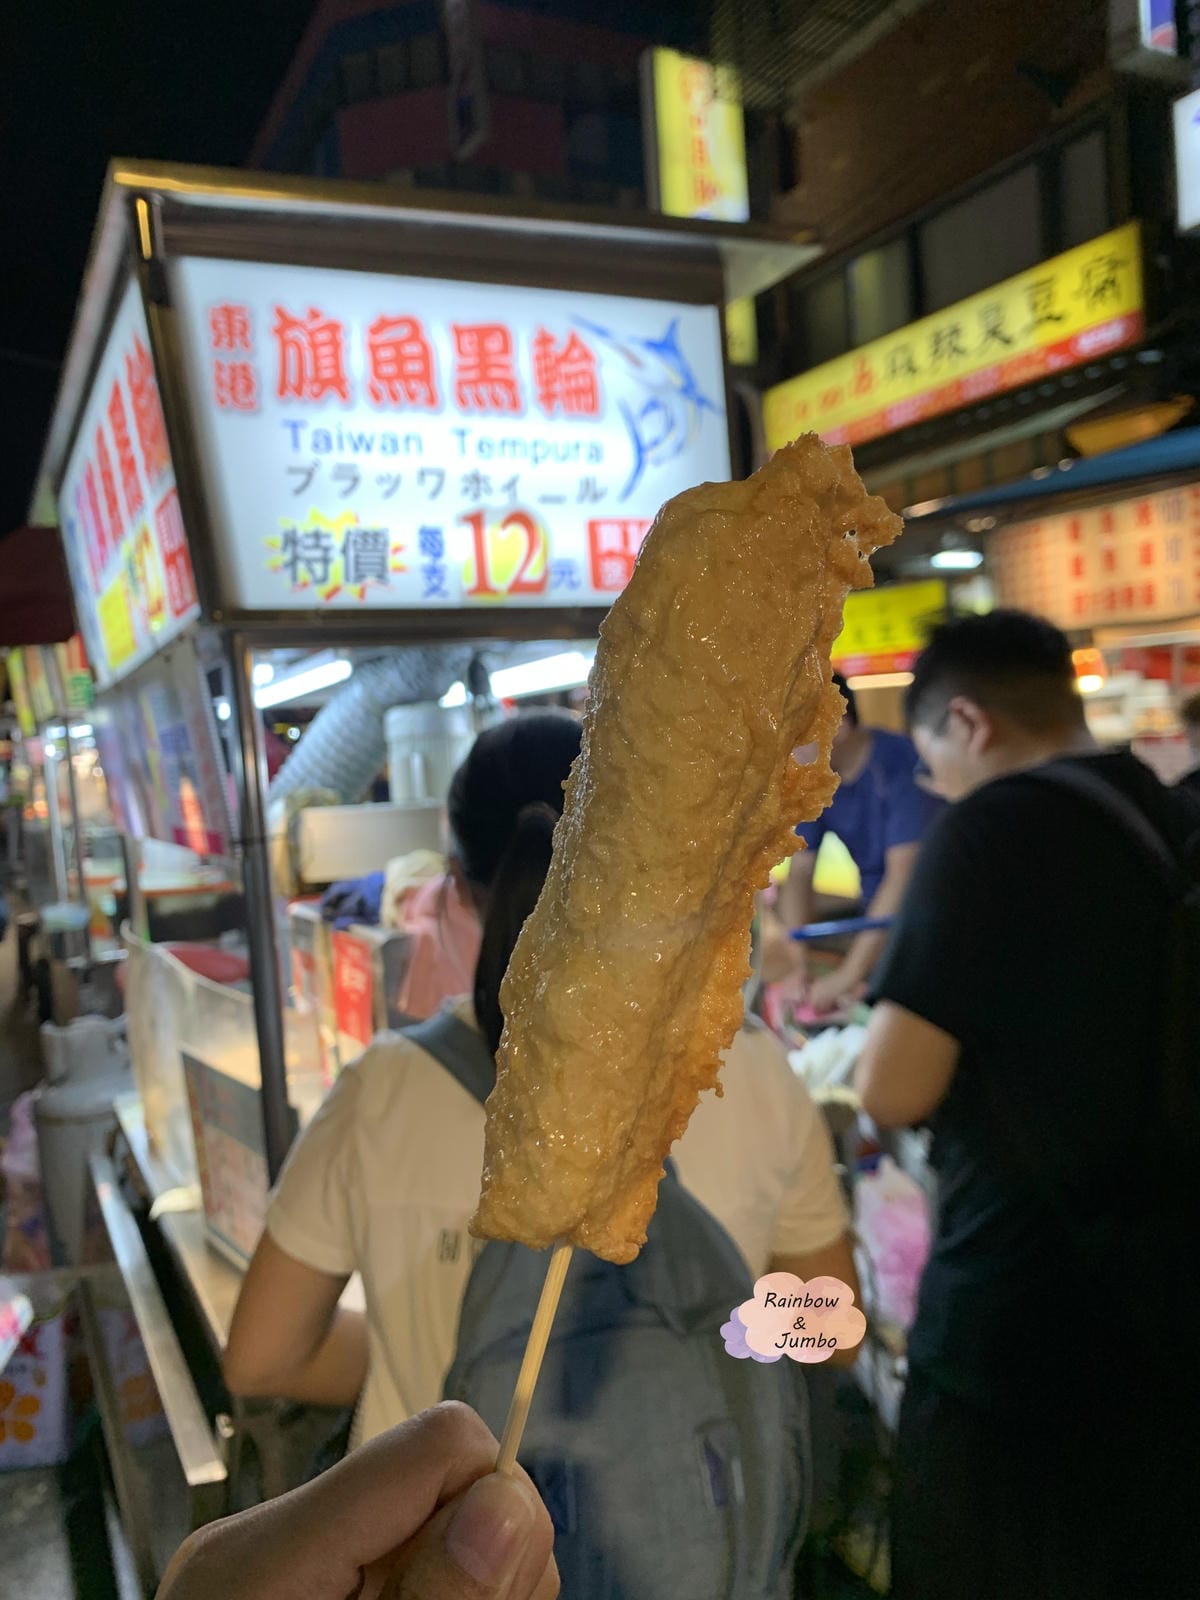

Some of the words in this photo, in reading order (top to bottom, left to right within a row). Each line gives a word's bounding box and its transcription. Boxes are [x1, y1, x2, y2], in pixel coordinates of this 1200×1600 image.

[209, 302, 256, 411] 東港
[272, 303, 600, 417] 旗魚黑輪
[282, 418, 424, 455] Taiwan
[454, 427, 605, 467] Tempura
[280, 525, 390, 586] 特價
[457, 509, 547, 597] 12
